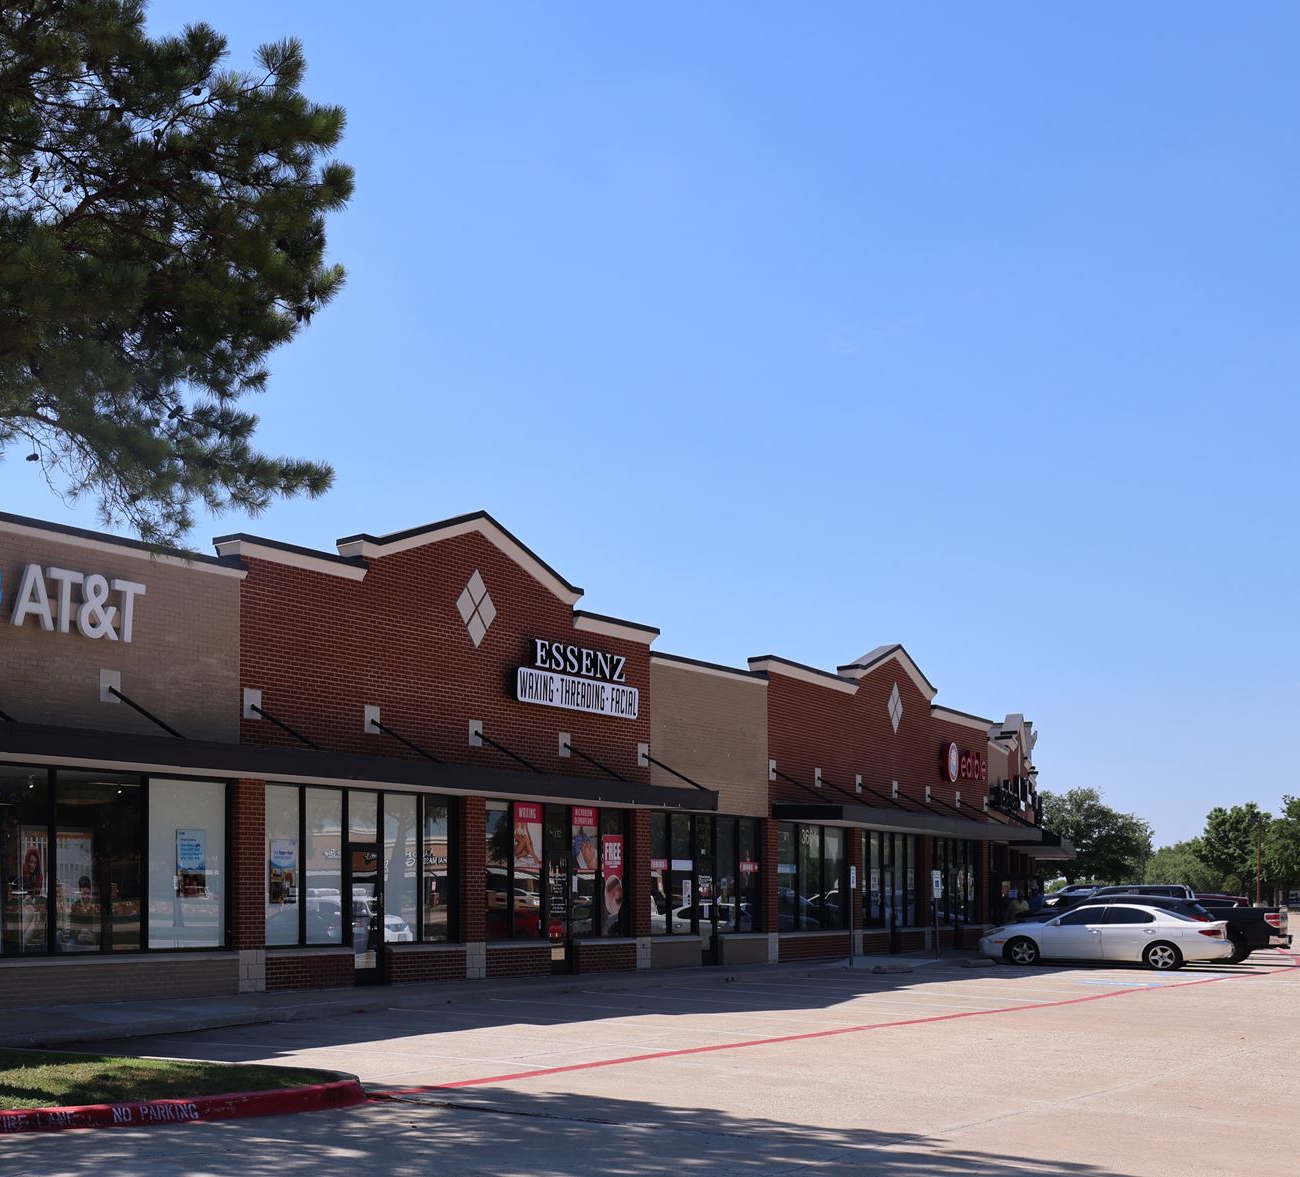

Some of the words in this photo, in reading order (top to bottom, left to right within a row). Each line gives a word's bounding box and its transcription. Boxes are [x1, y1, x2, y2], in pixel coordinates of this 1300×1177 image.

[10, 563, 146, 643] AT&T
[534, 639, 626, 682] ESSENZ
[519, 670, 554, 703] WAXING
[560, 678, 605, 711] THREADING
[610, 687, 637, 716] FACIAL
[960, 752, 987, 781] edible
[604, 842, 621, 861] FREE
[112, 1107, 132, 1123] NO
[139, 1103, 199, 1121] PARKING
